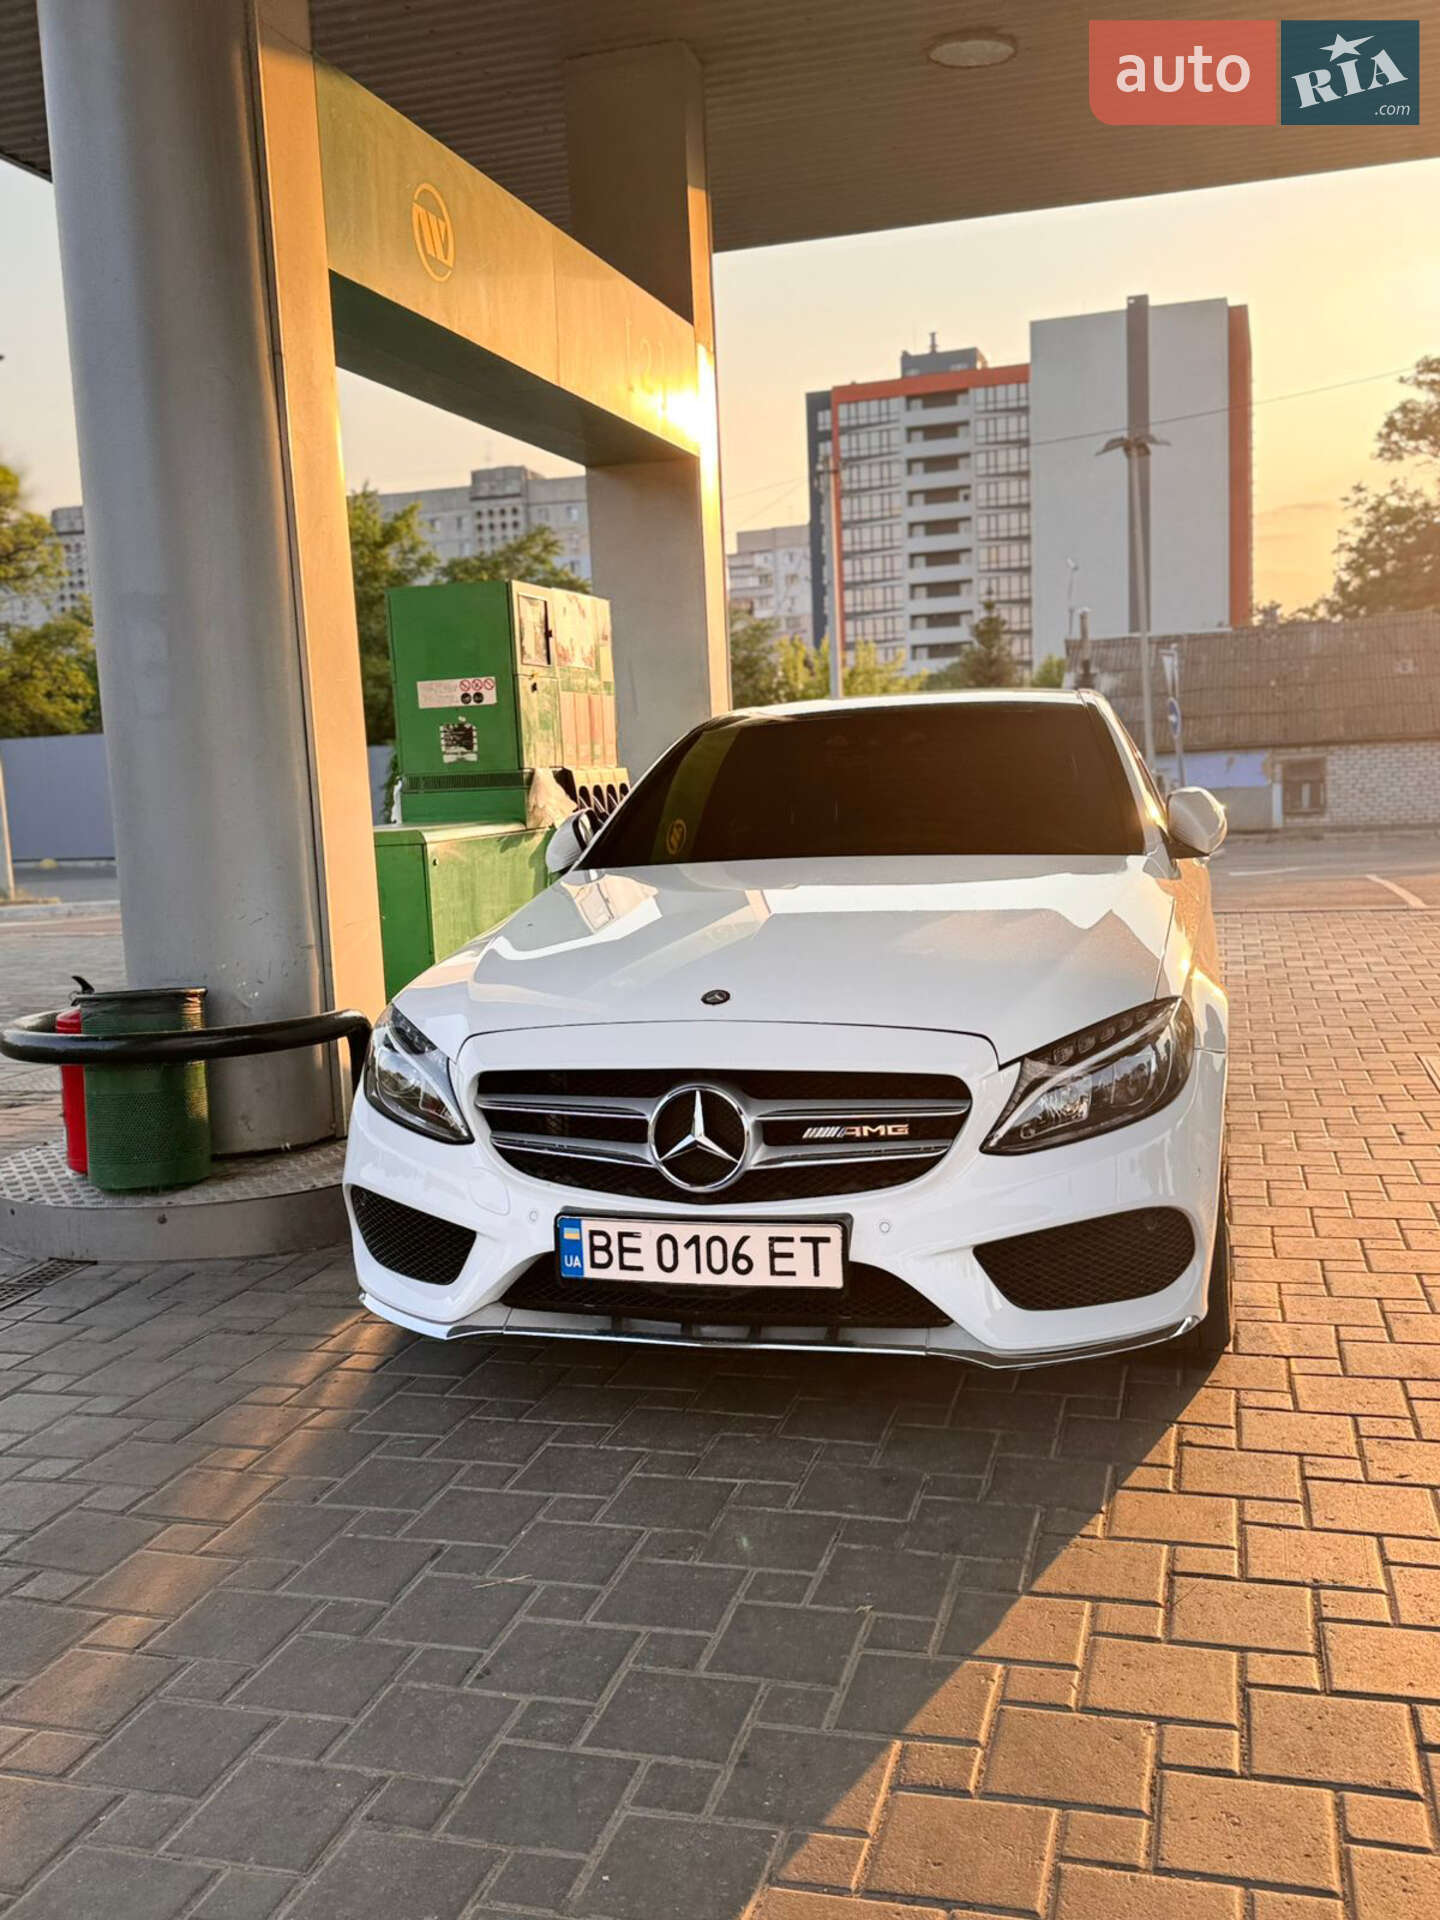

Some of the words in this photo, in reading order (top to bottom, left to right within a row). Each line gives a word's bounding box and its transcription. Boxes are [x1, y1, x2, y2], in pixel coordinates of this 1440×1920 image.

[841, 1123, 909, 1138] AMG
[588, 1229, 644, 1272] BE
[656, 1233, 754, 1276] 0106
[768, 1236, 831, 1277] ET
[564, 1255, 582, 1269] UA
